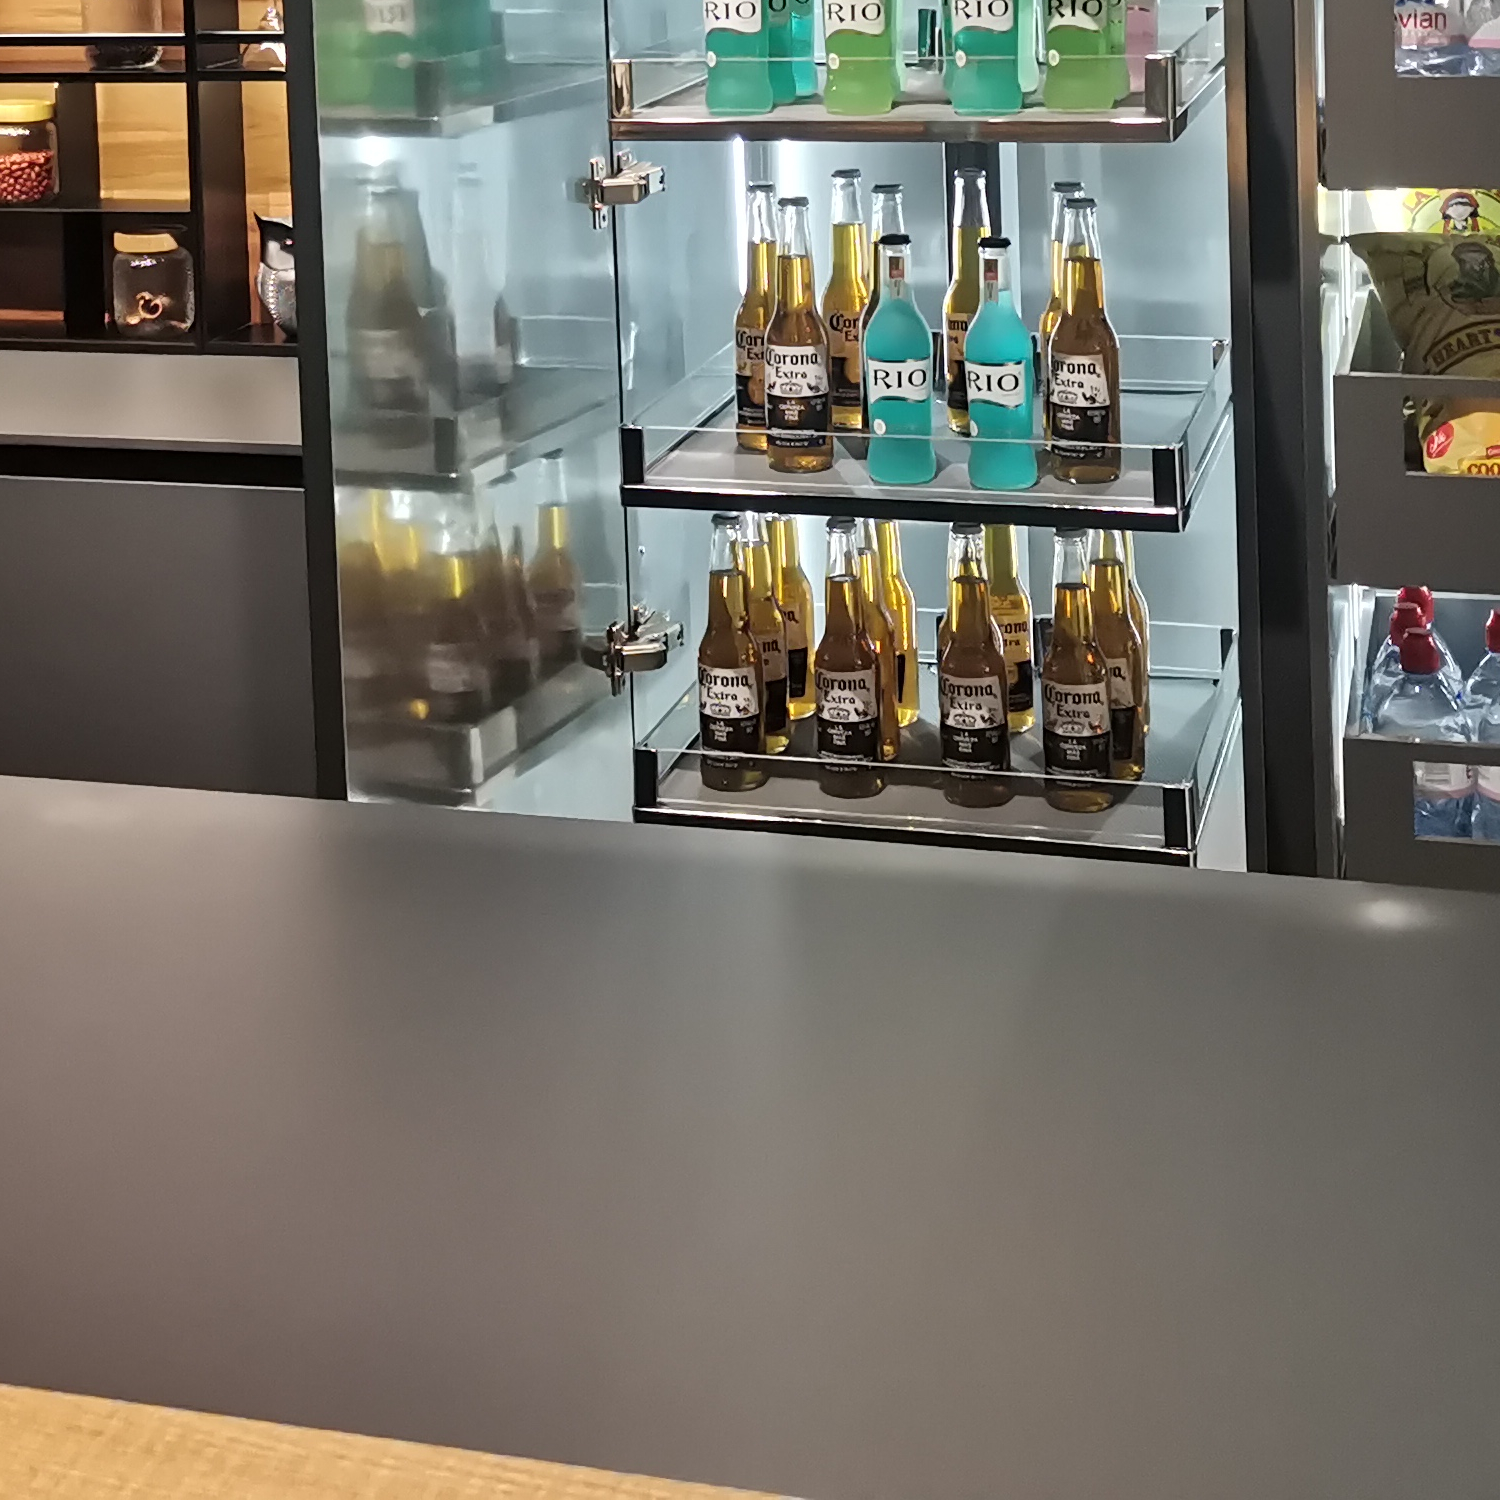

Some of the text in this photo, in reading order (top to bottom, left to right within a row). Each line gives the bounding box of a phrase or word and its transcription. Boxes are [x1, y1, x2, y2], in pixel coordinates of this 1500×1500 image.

[705, 1, 757, 21] RIO
[827, 2, 882, 24] RIO
[1394, 9, 1447, 30] vian
[766, 348, 820, 367] Corona
[1432, 329, 1493, 368] HEART
[775, 366, 808, 380] Extra
[873, 369, 927, 389] RIO
[967, 370, 1020, 393] RIO
[1055, 373, 1084, 388] Extra
[700, 666, 751, 688] Corona
[816, 670, 870, 692] Corona
[941, 678, 997, 698] Corona
[1044, 683, 1104, 706] Corona
